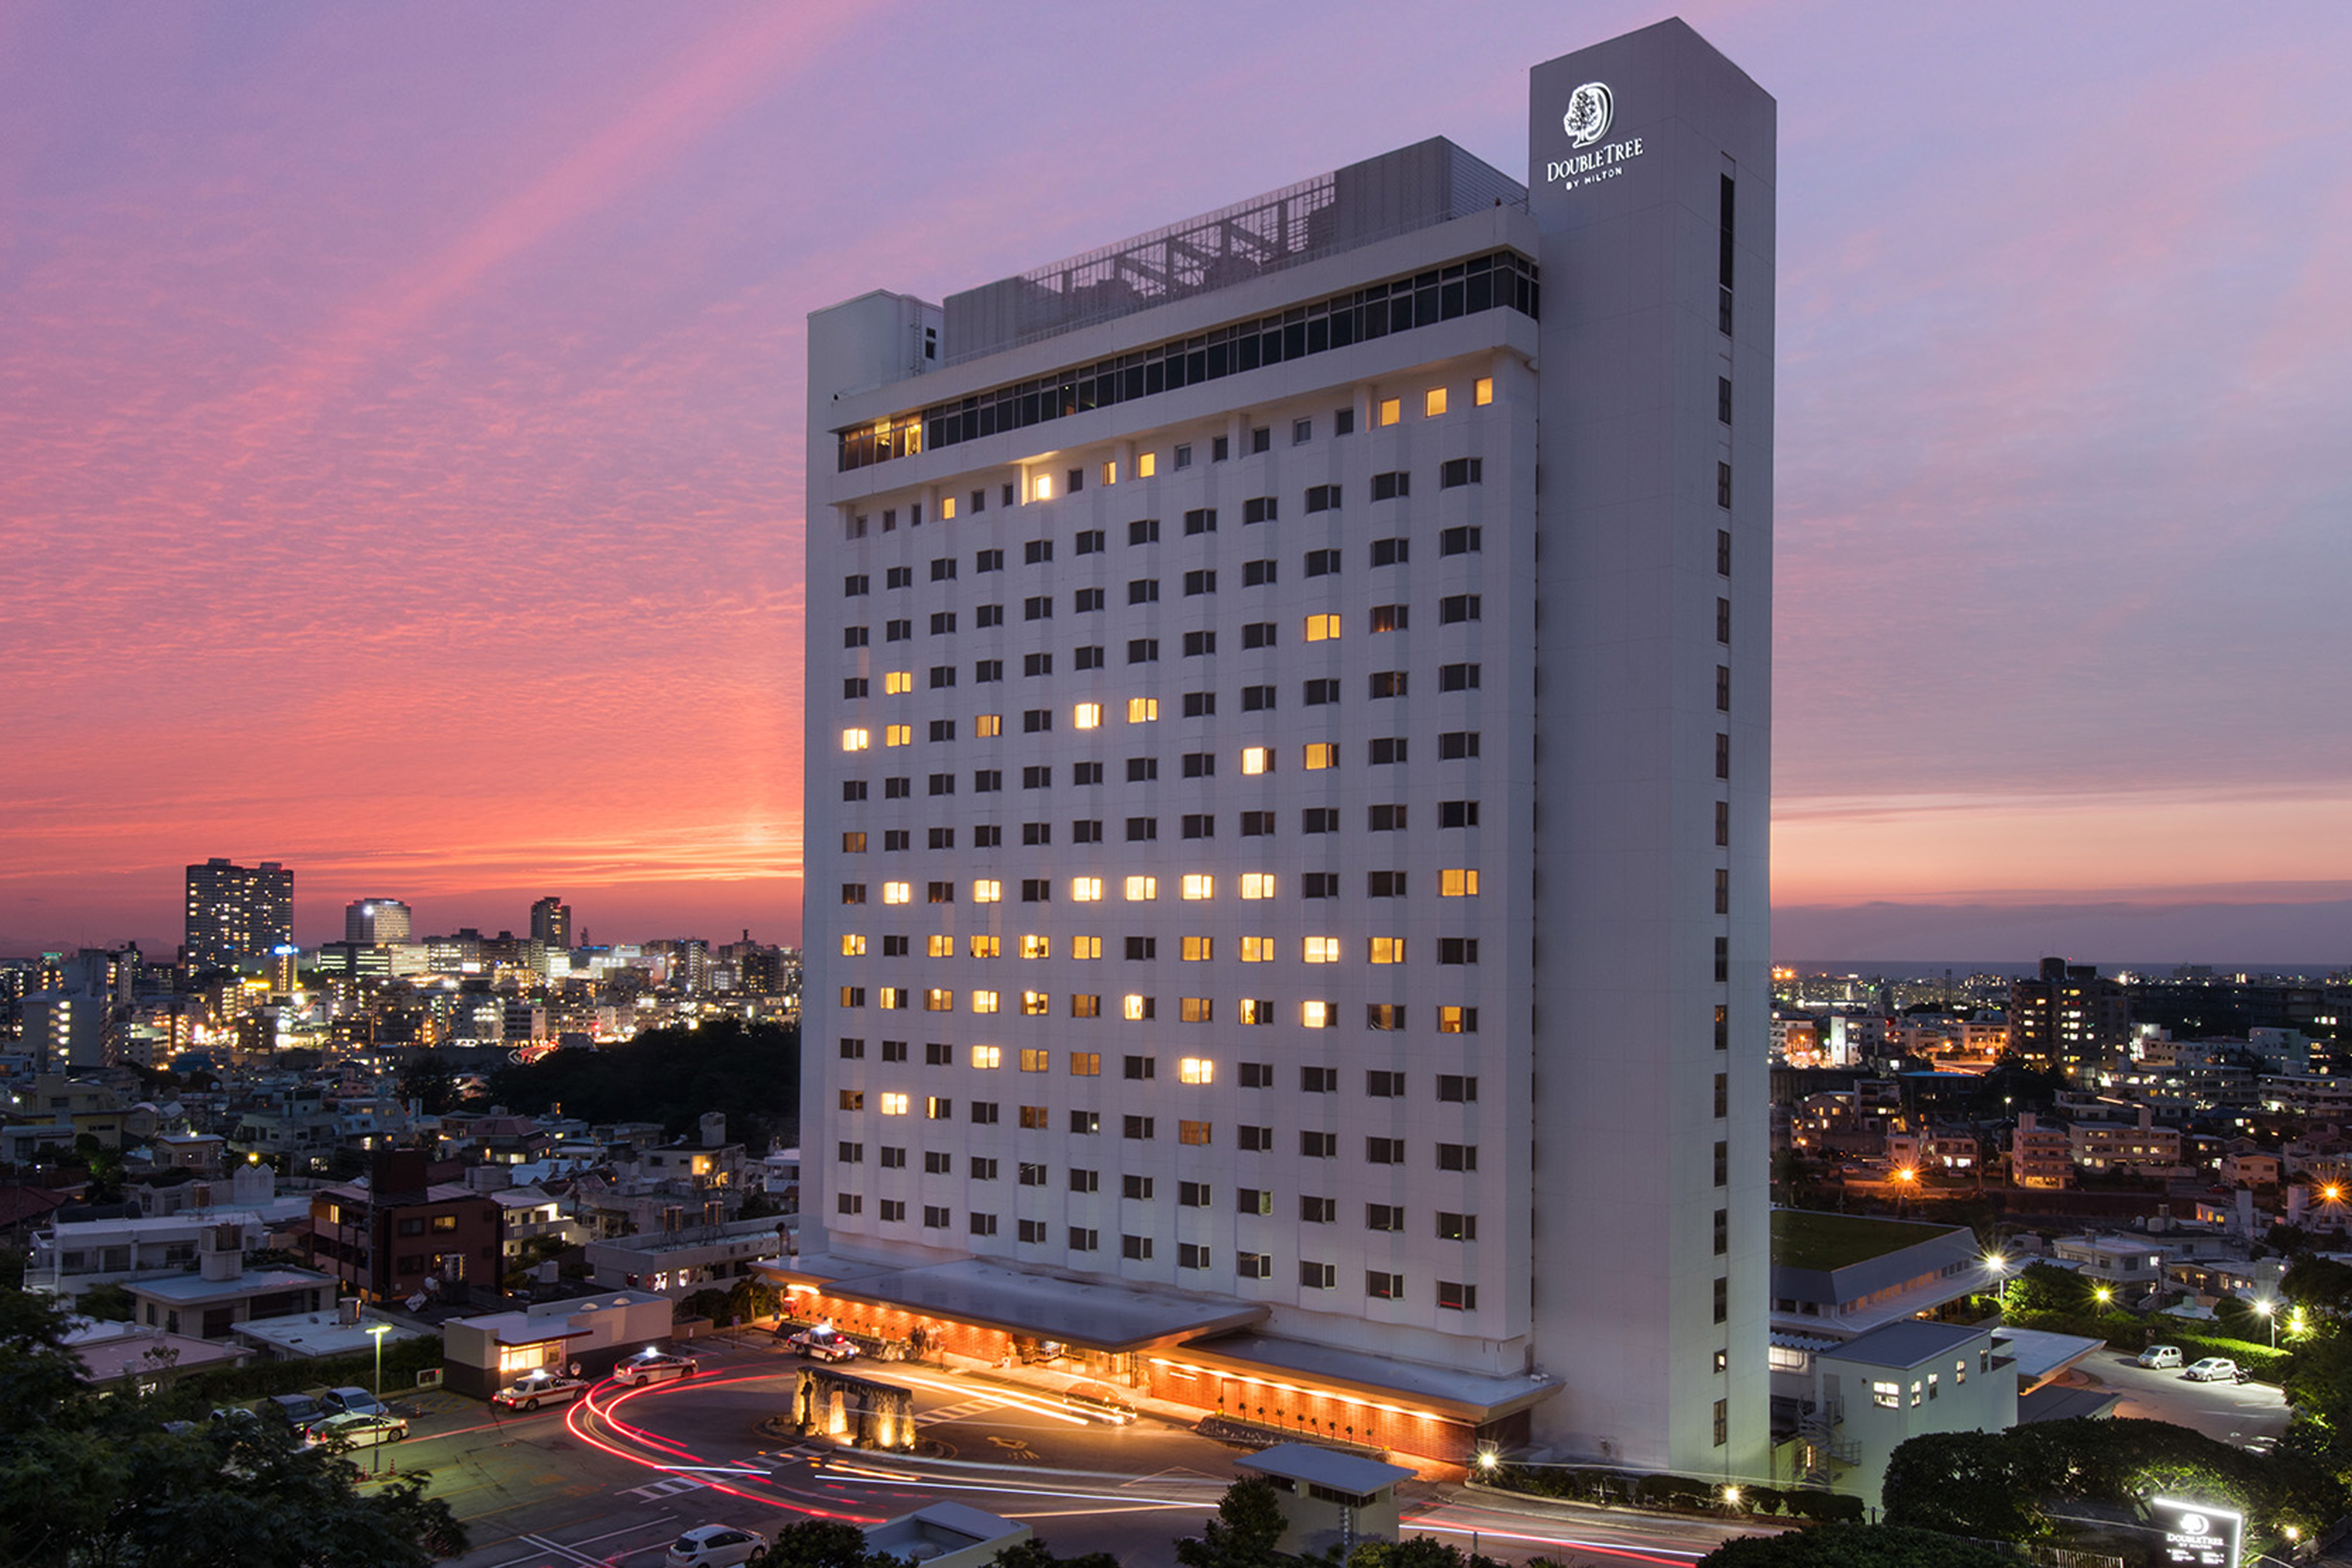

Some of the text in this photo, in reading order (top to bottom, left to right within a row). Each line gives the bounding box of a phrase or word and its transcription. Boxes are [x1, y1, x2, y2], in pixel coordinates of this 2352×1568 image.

[1547, 137, 1643, 182] DOUBLETREE
[1566, 167, 1622, 190] BY HILTON
